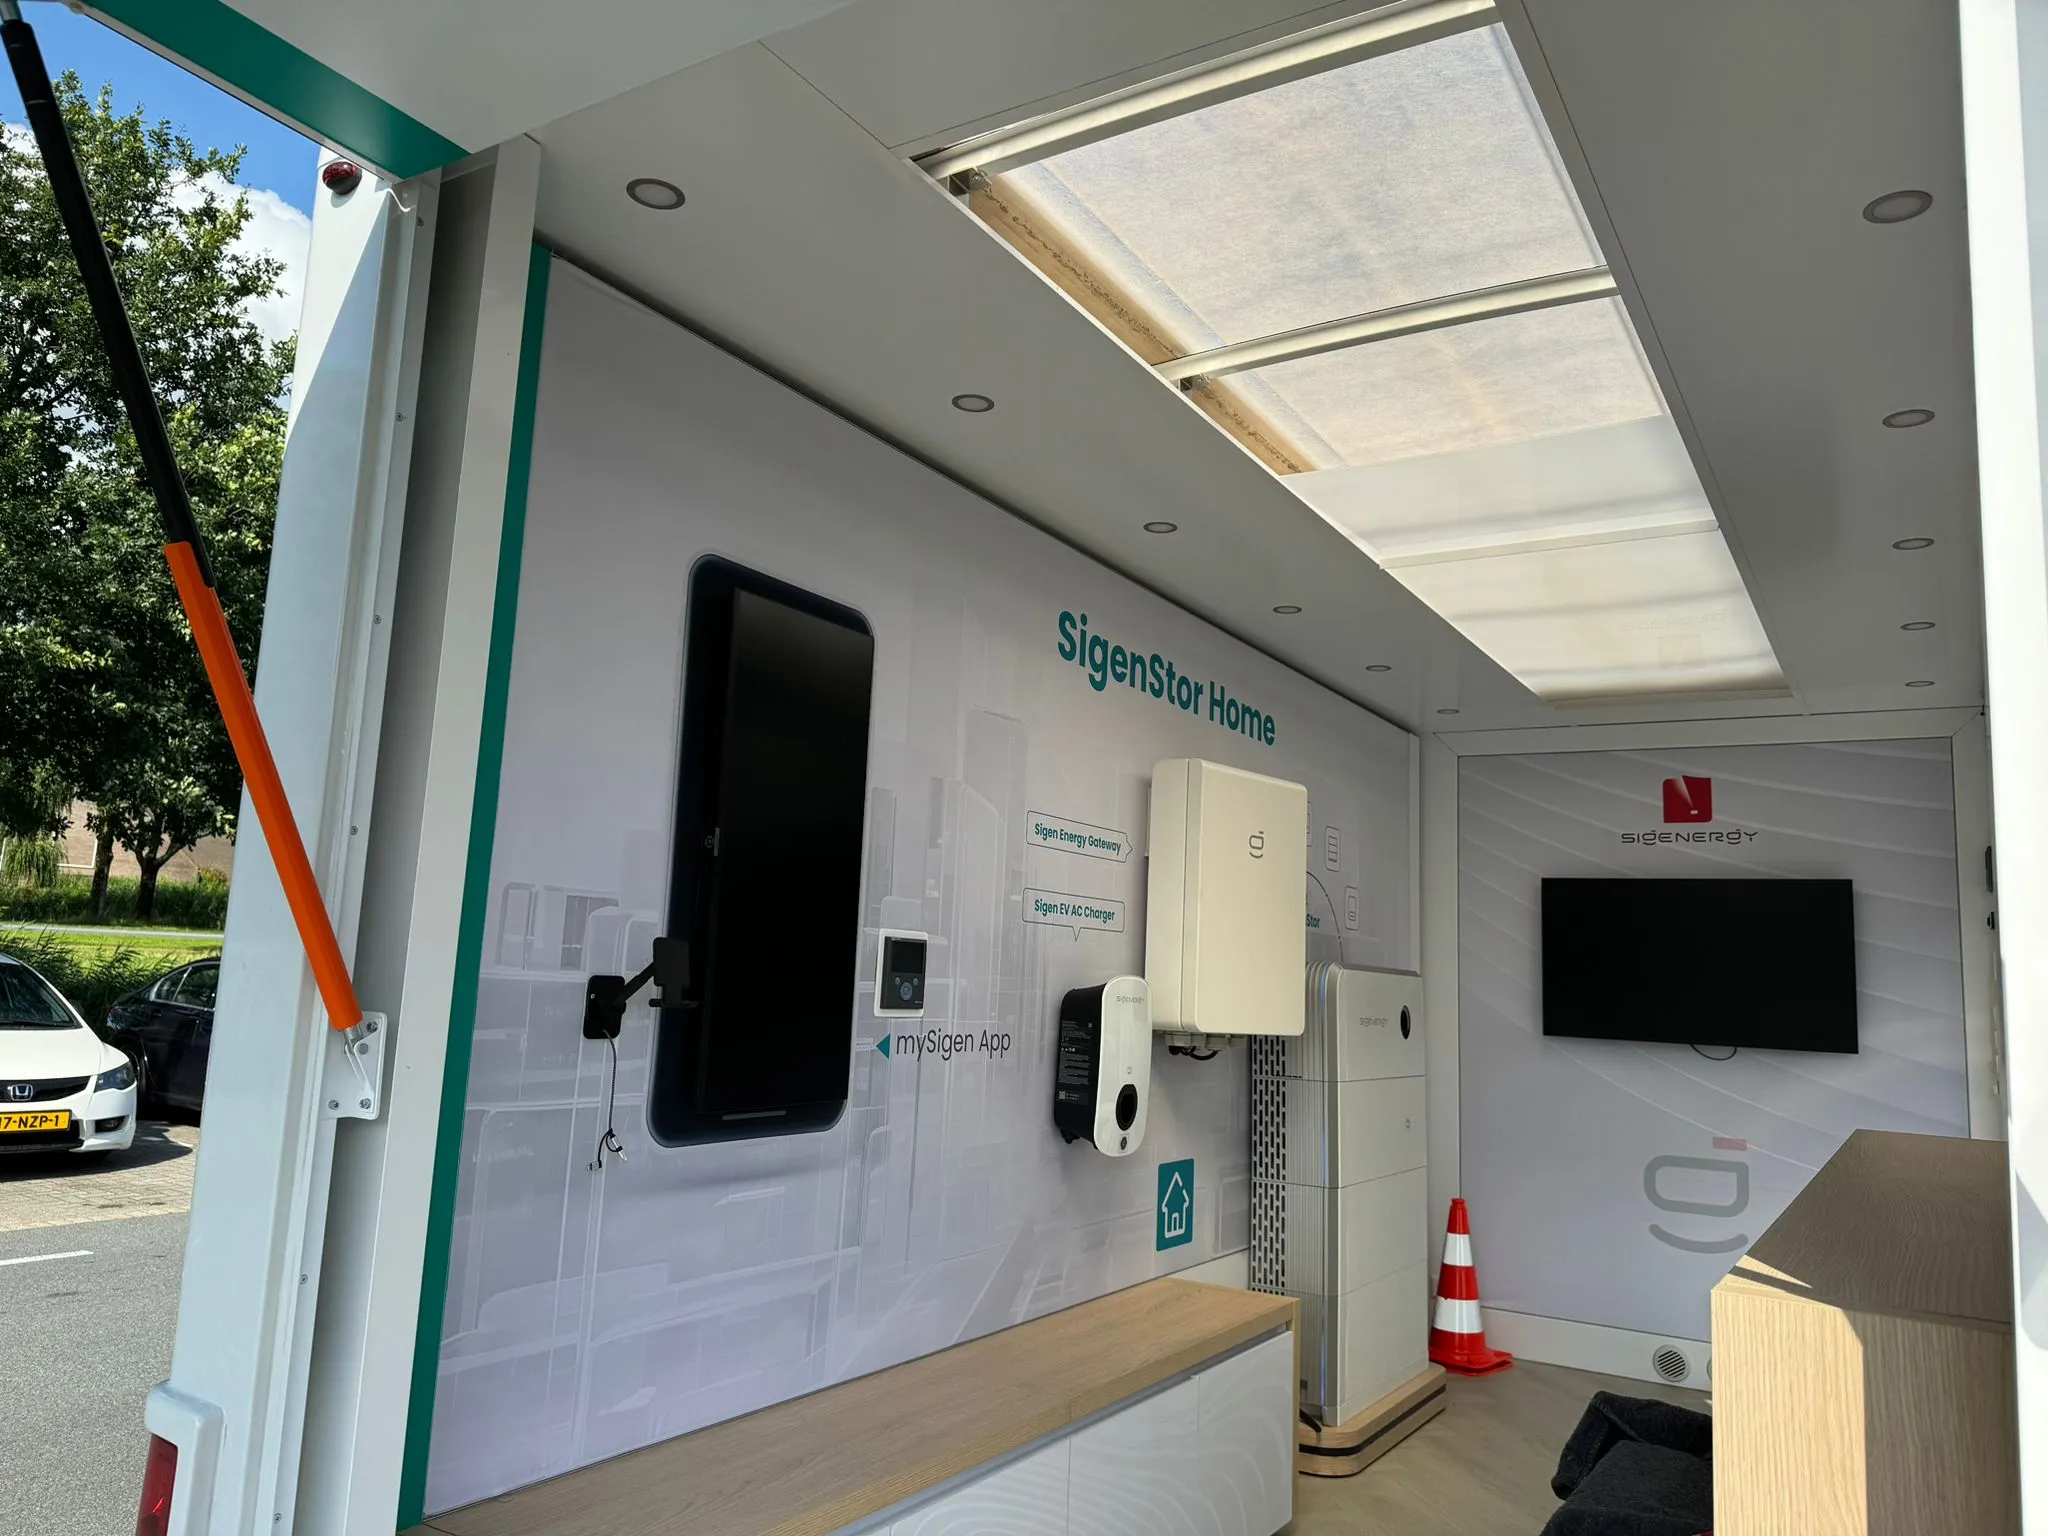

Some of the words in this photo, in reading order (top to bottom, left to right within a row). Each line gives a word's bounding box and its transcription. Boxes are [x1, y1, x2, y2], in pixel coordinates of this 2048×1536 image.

[1058, 610, 1204, 715] SigenStor
[1209, 680, 1276, 746] Home
[1034, 822, 1058, 841] Sigen
[1060, 828, 1087, 849] Energy
[1088, 835, 1122, 856] Gateway
[1621, 828, 1758, 846] SIGENERGY
[1034, 898, 1058, 917] Sigen
[1059, 902, 1071, 916] EV
[1071, 905, 1083, 917] AC
[1084, 905, 1115, 924] Charger
[896, 1027, 974, 1062] mySigen
[978, 1029, 1011, 1059] App
